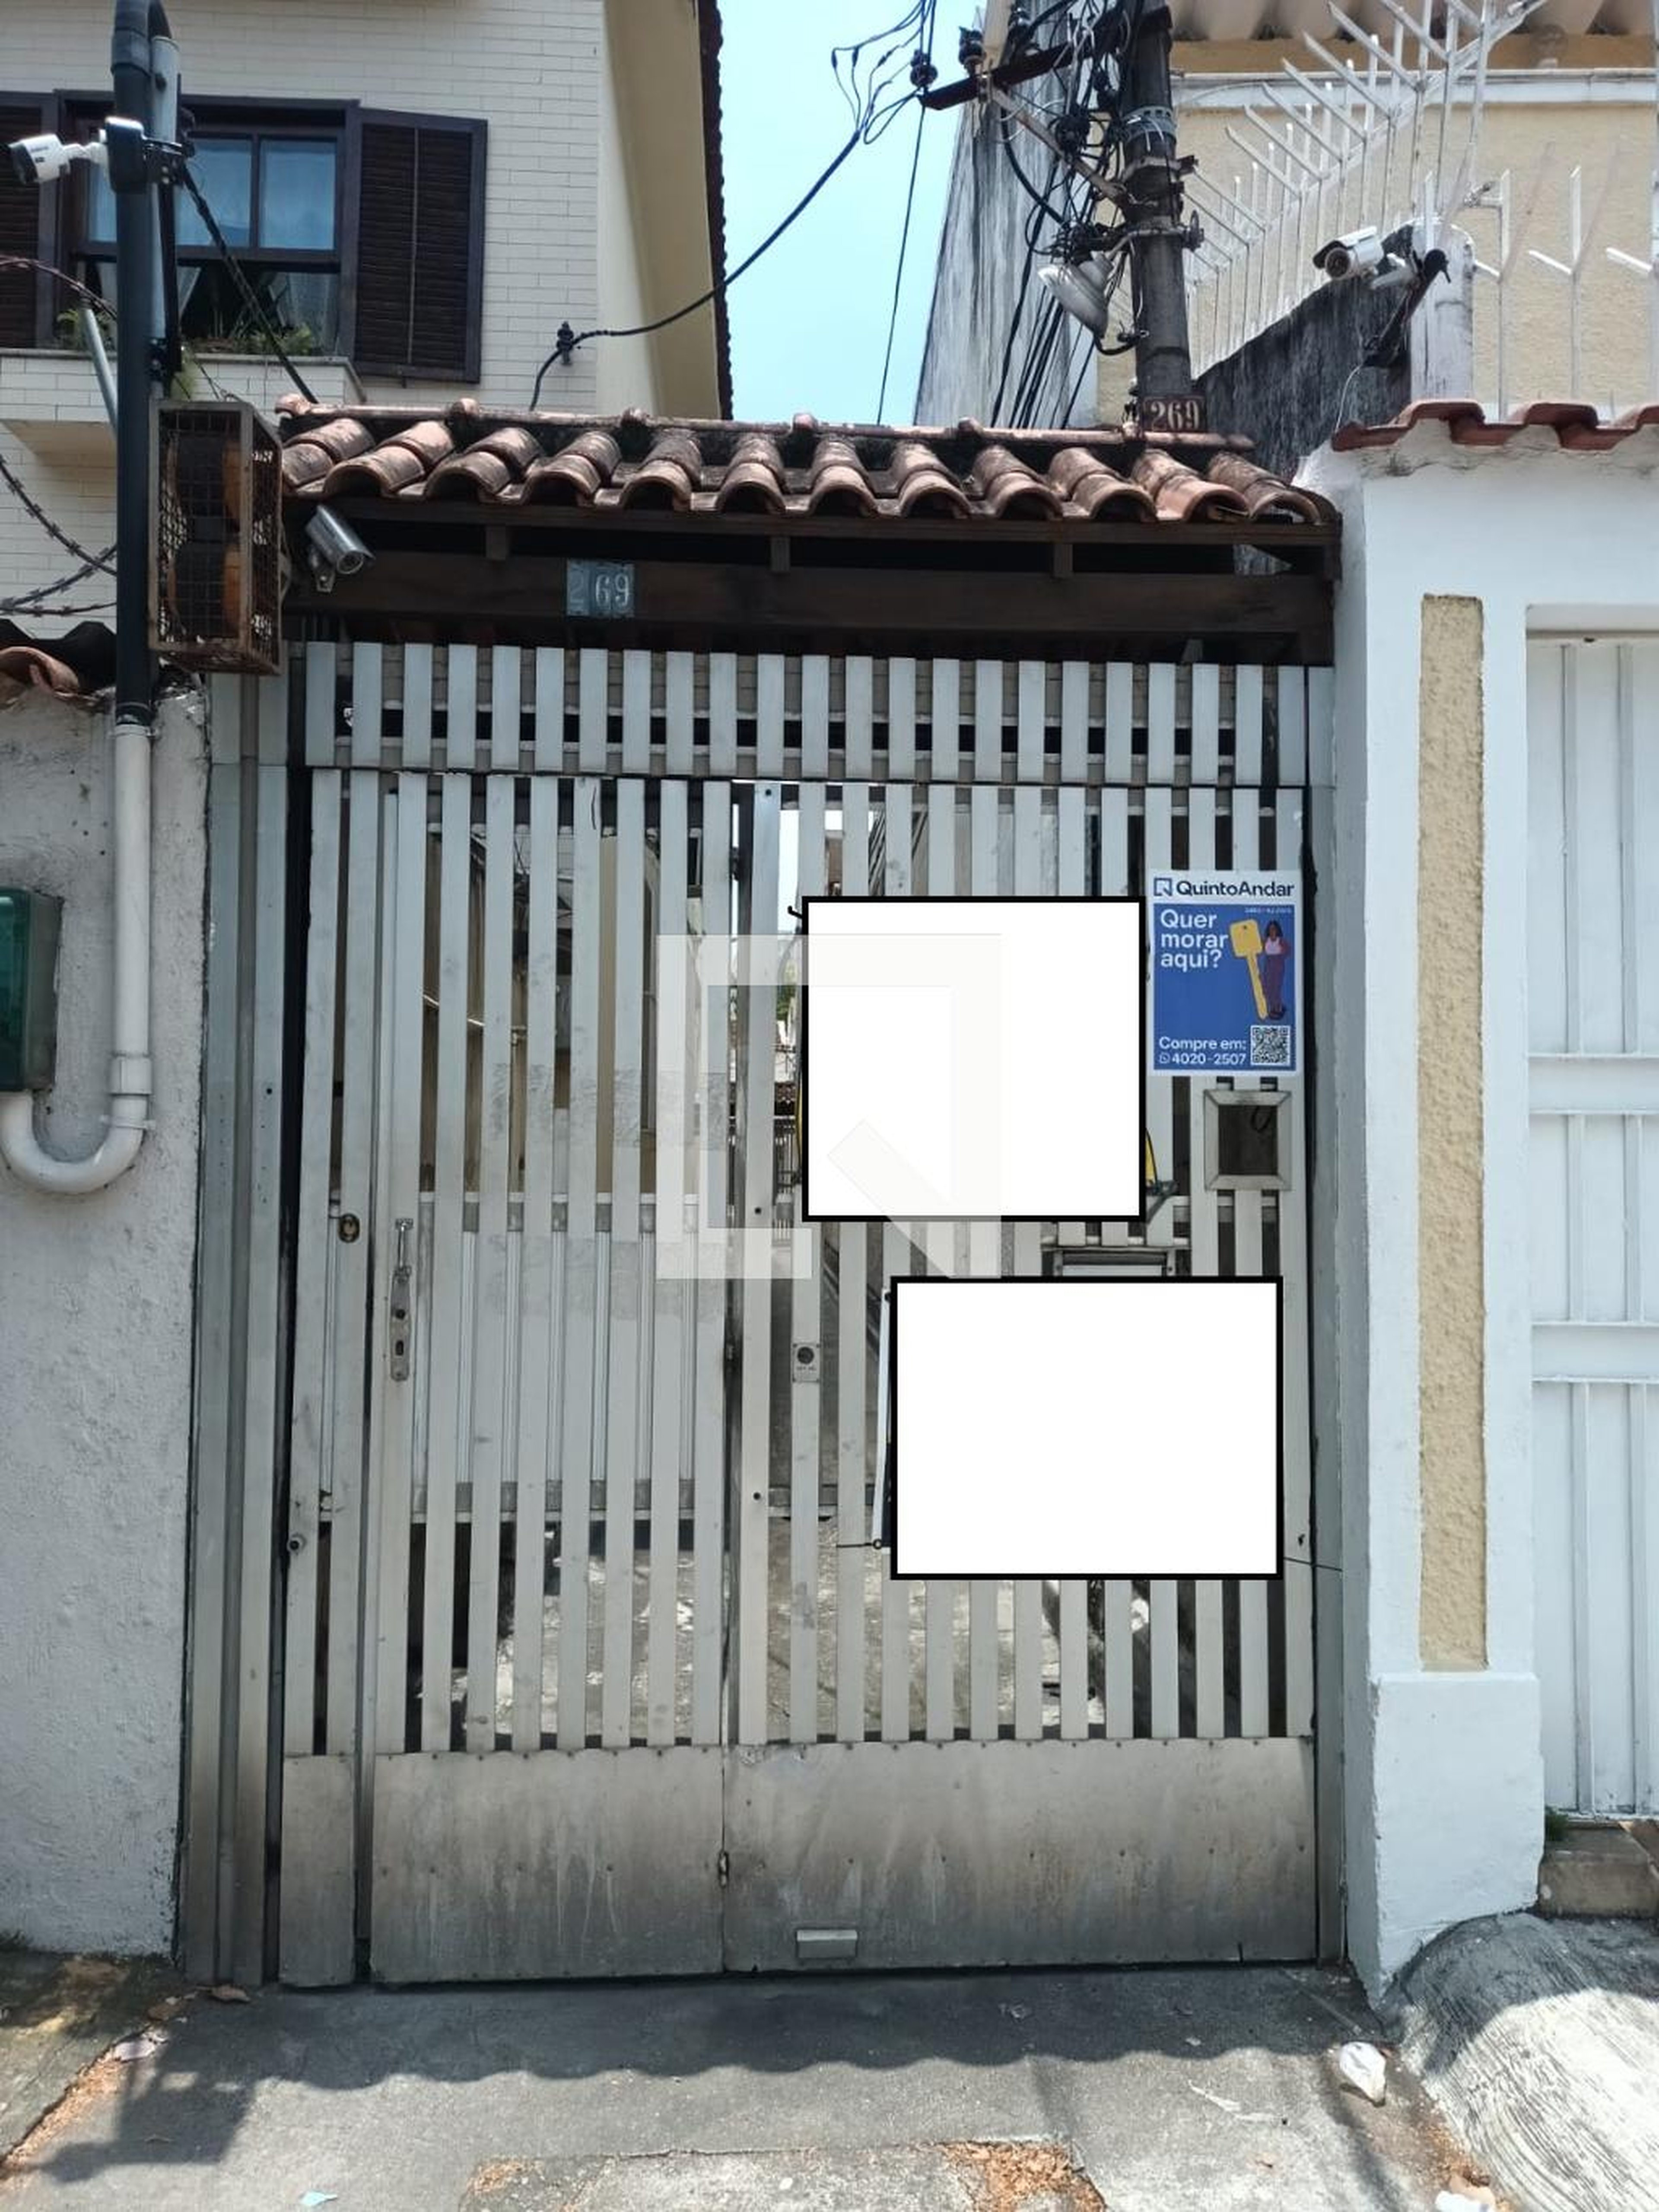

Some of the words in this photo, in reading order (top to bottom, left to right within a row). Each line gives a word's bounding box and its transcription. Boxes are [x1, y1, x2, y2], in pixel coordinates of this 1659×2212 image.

[1151, 401, 1199, 432] 269
[1176, 881, 1294, 897] QuintoAndar
[1161, 909, 1217, 929] Quer
[1161, 934, 1229, 948] morar
[1161, 949, 1222, 972] aqui?
[1159, 1036, 1217, 1052] Compre
[1220, 1040, 1246, 1050] em:
